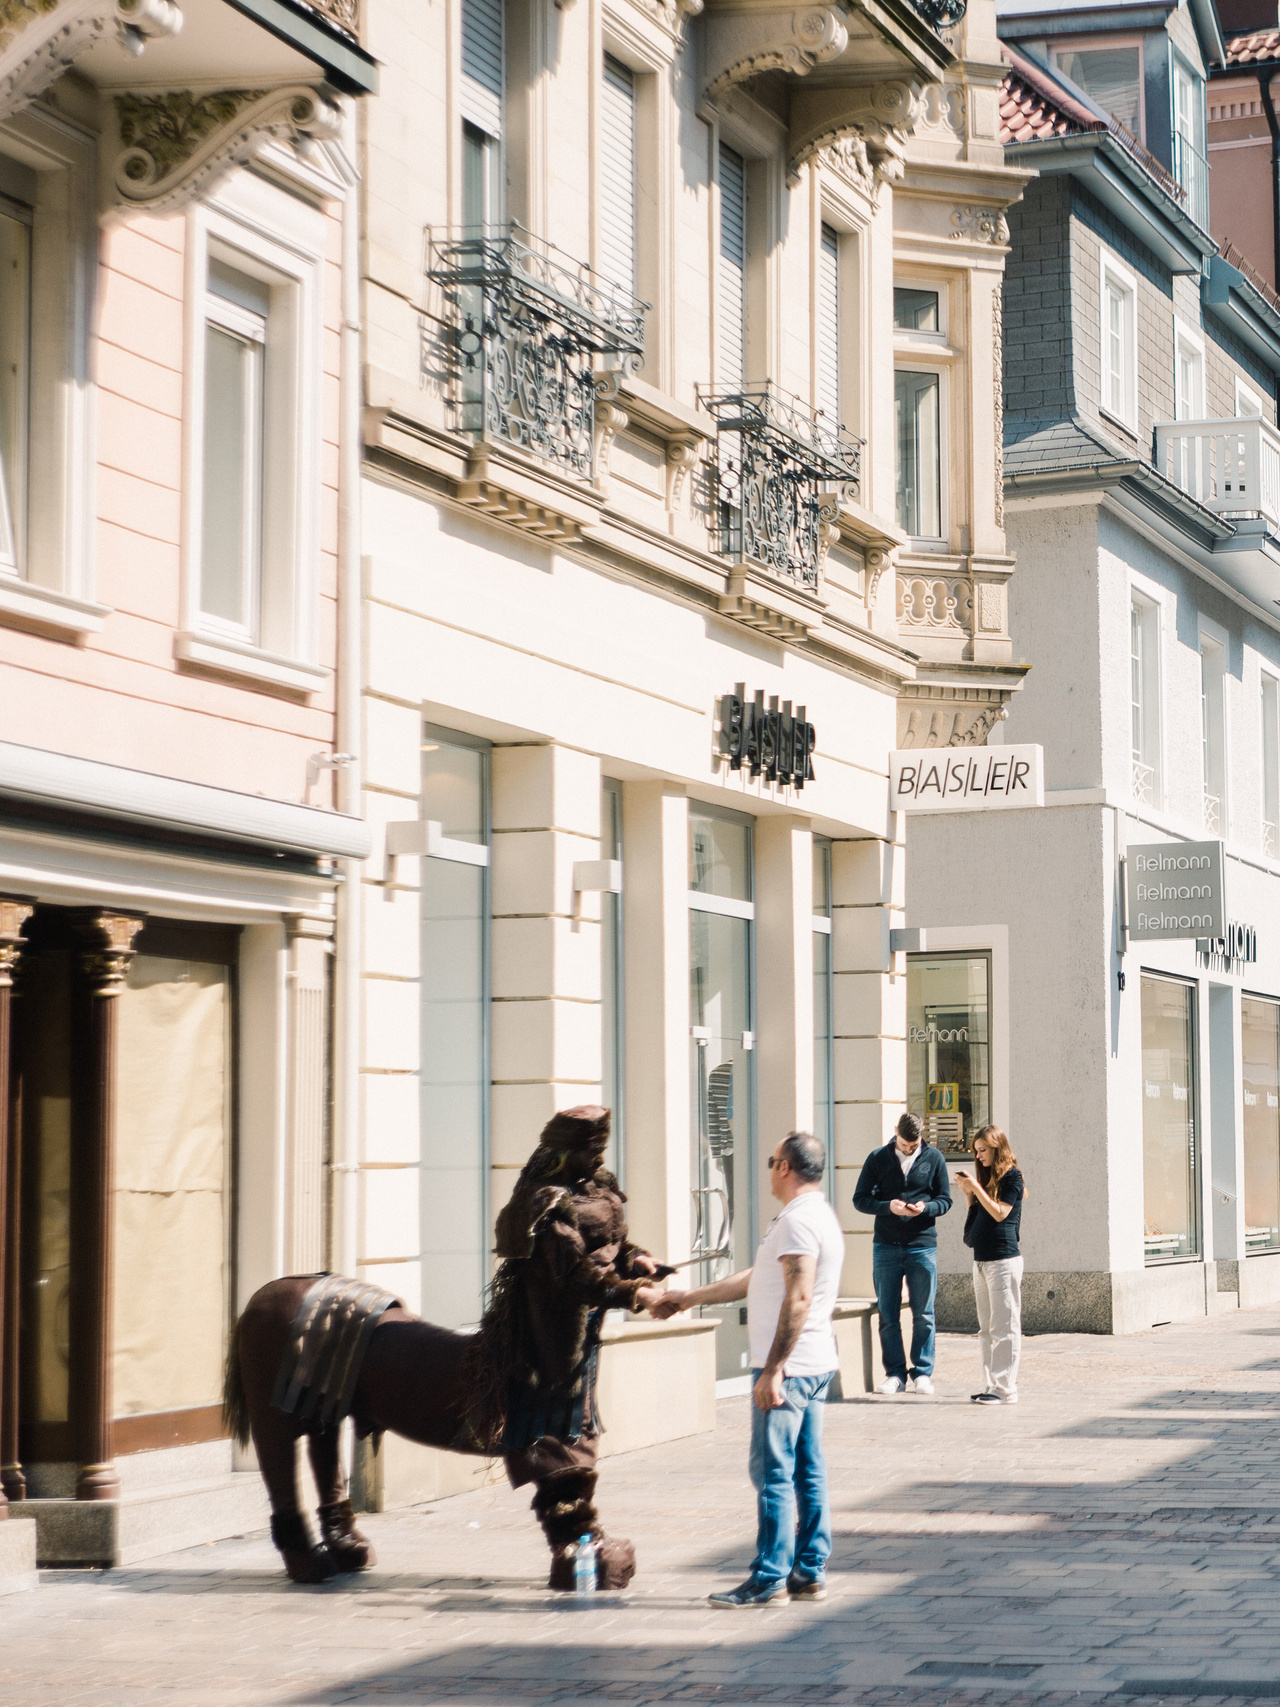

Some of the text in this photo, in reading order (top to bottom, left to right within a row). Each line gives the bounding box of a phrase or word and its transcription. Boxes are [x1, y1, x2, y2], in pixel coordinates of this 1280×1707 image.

[1136, 853, 1211, 872] fielmann
[1137, 883, 1212, 901] fielmann
[1137, 912, 1213, 931] fielmann
[908, 1025, 968, 1043] fielmann
